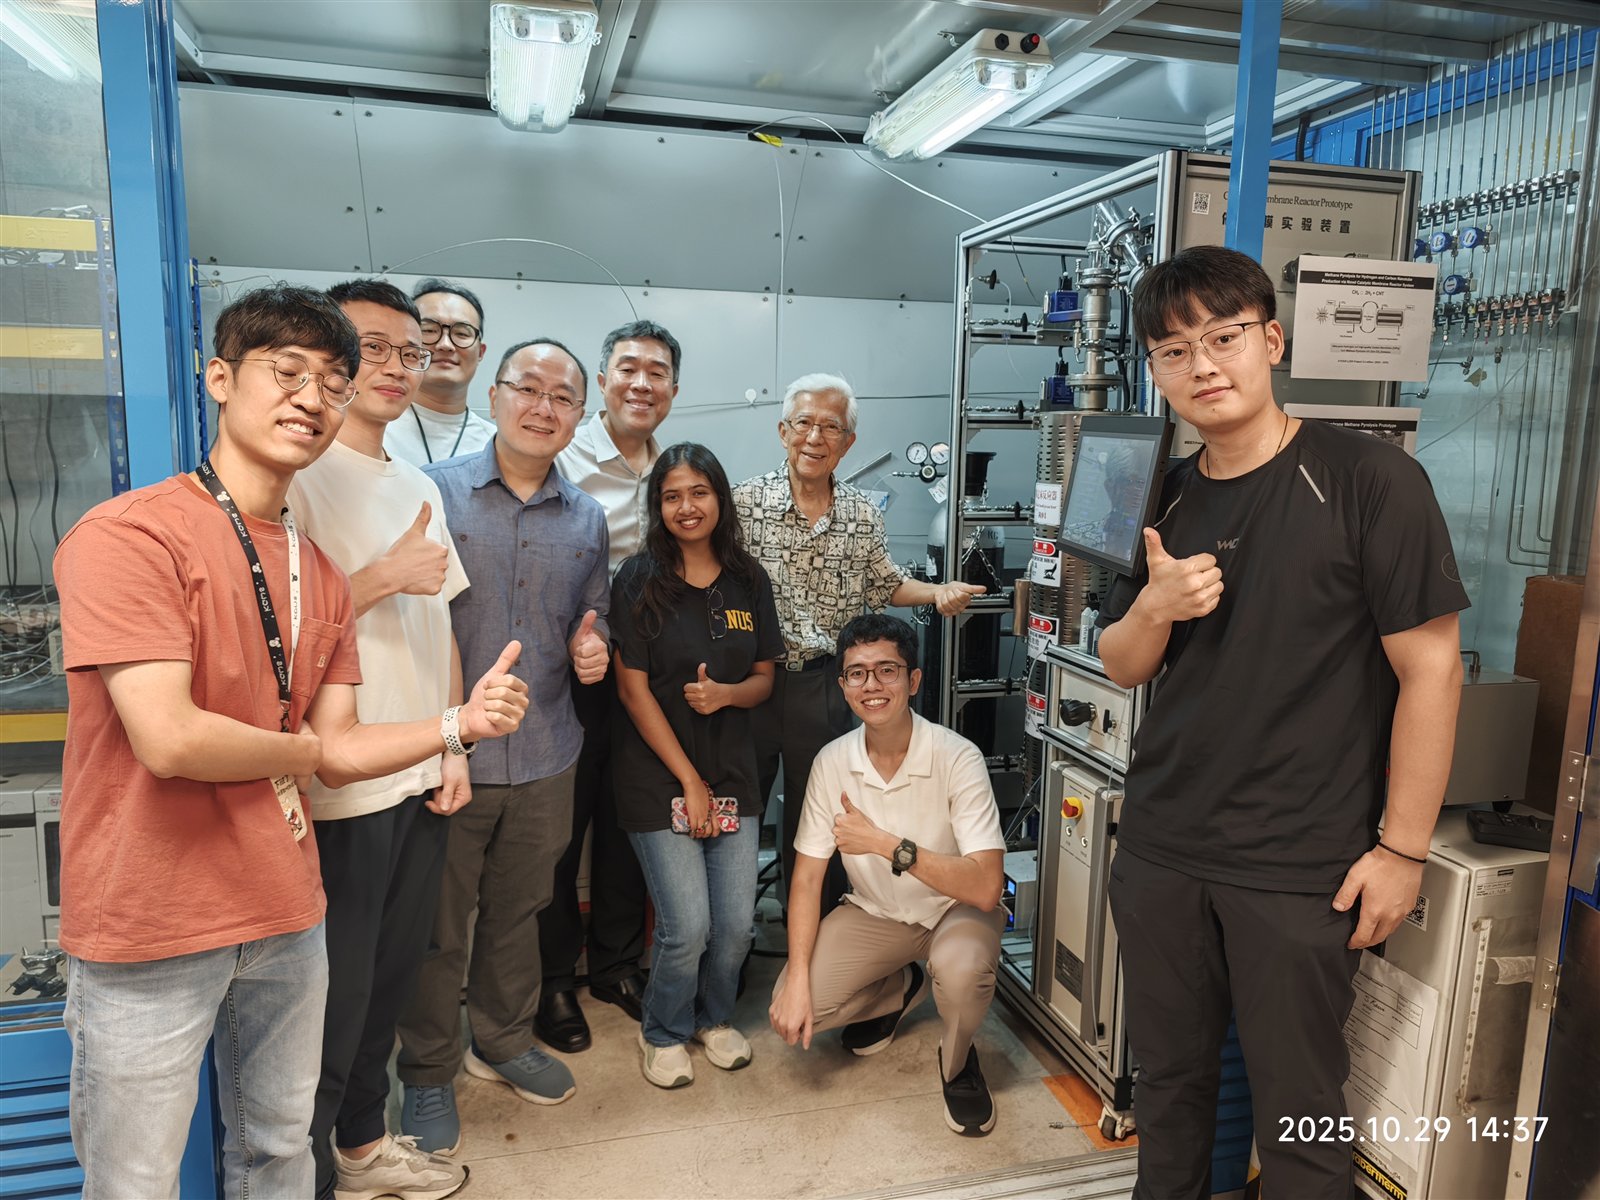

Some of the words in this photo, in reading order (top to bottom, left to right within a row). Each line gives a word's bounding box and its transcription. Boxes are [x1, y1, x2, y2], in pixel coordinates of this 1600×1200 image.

[1267, 195, 1293, 205] mbrane
[1294, 196, 1320, 207] Reactor
[1320, 198, 1353, 211] Prototype
[725, 609, 754, 632] NUS
[1353, 1152, 1407, 1200] abertherm
